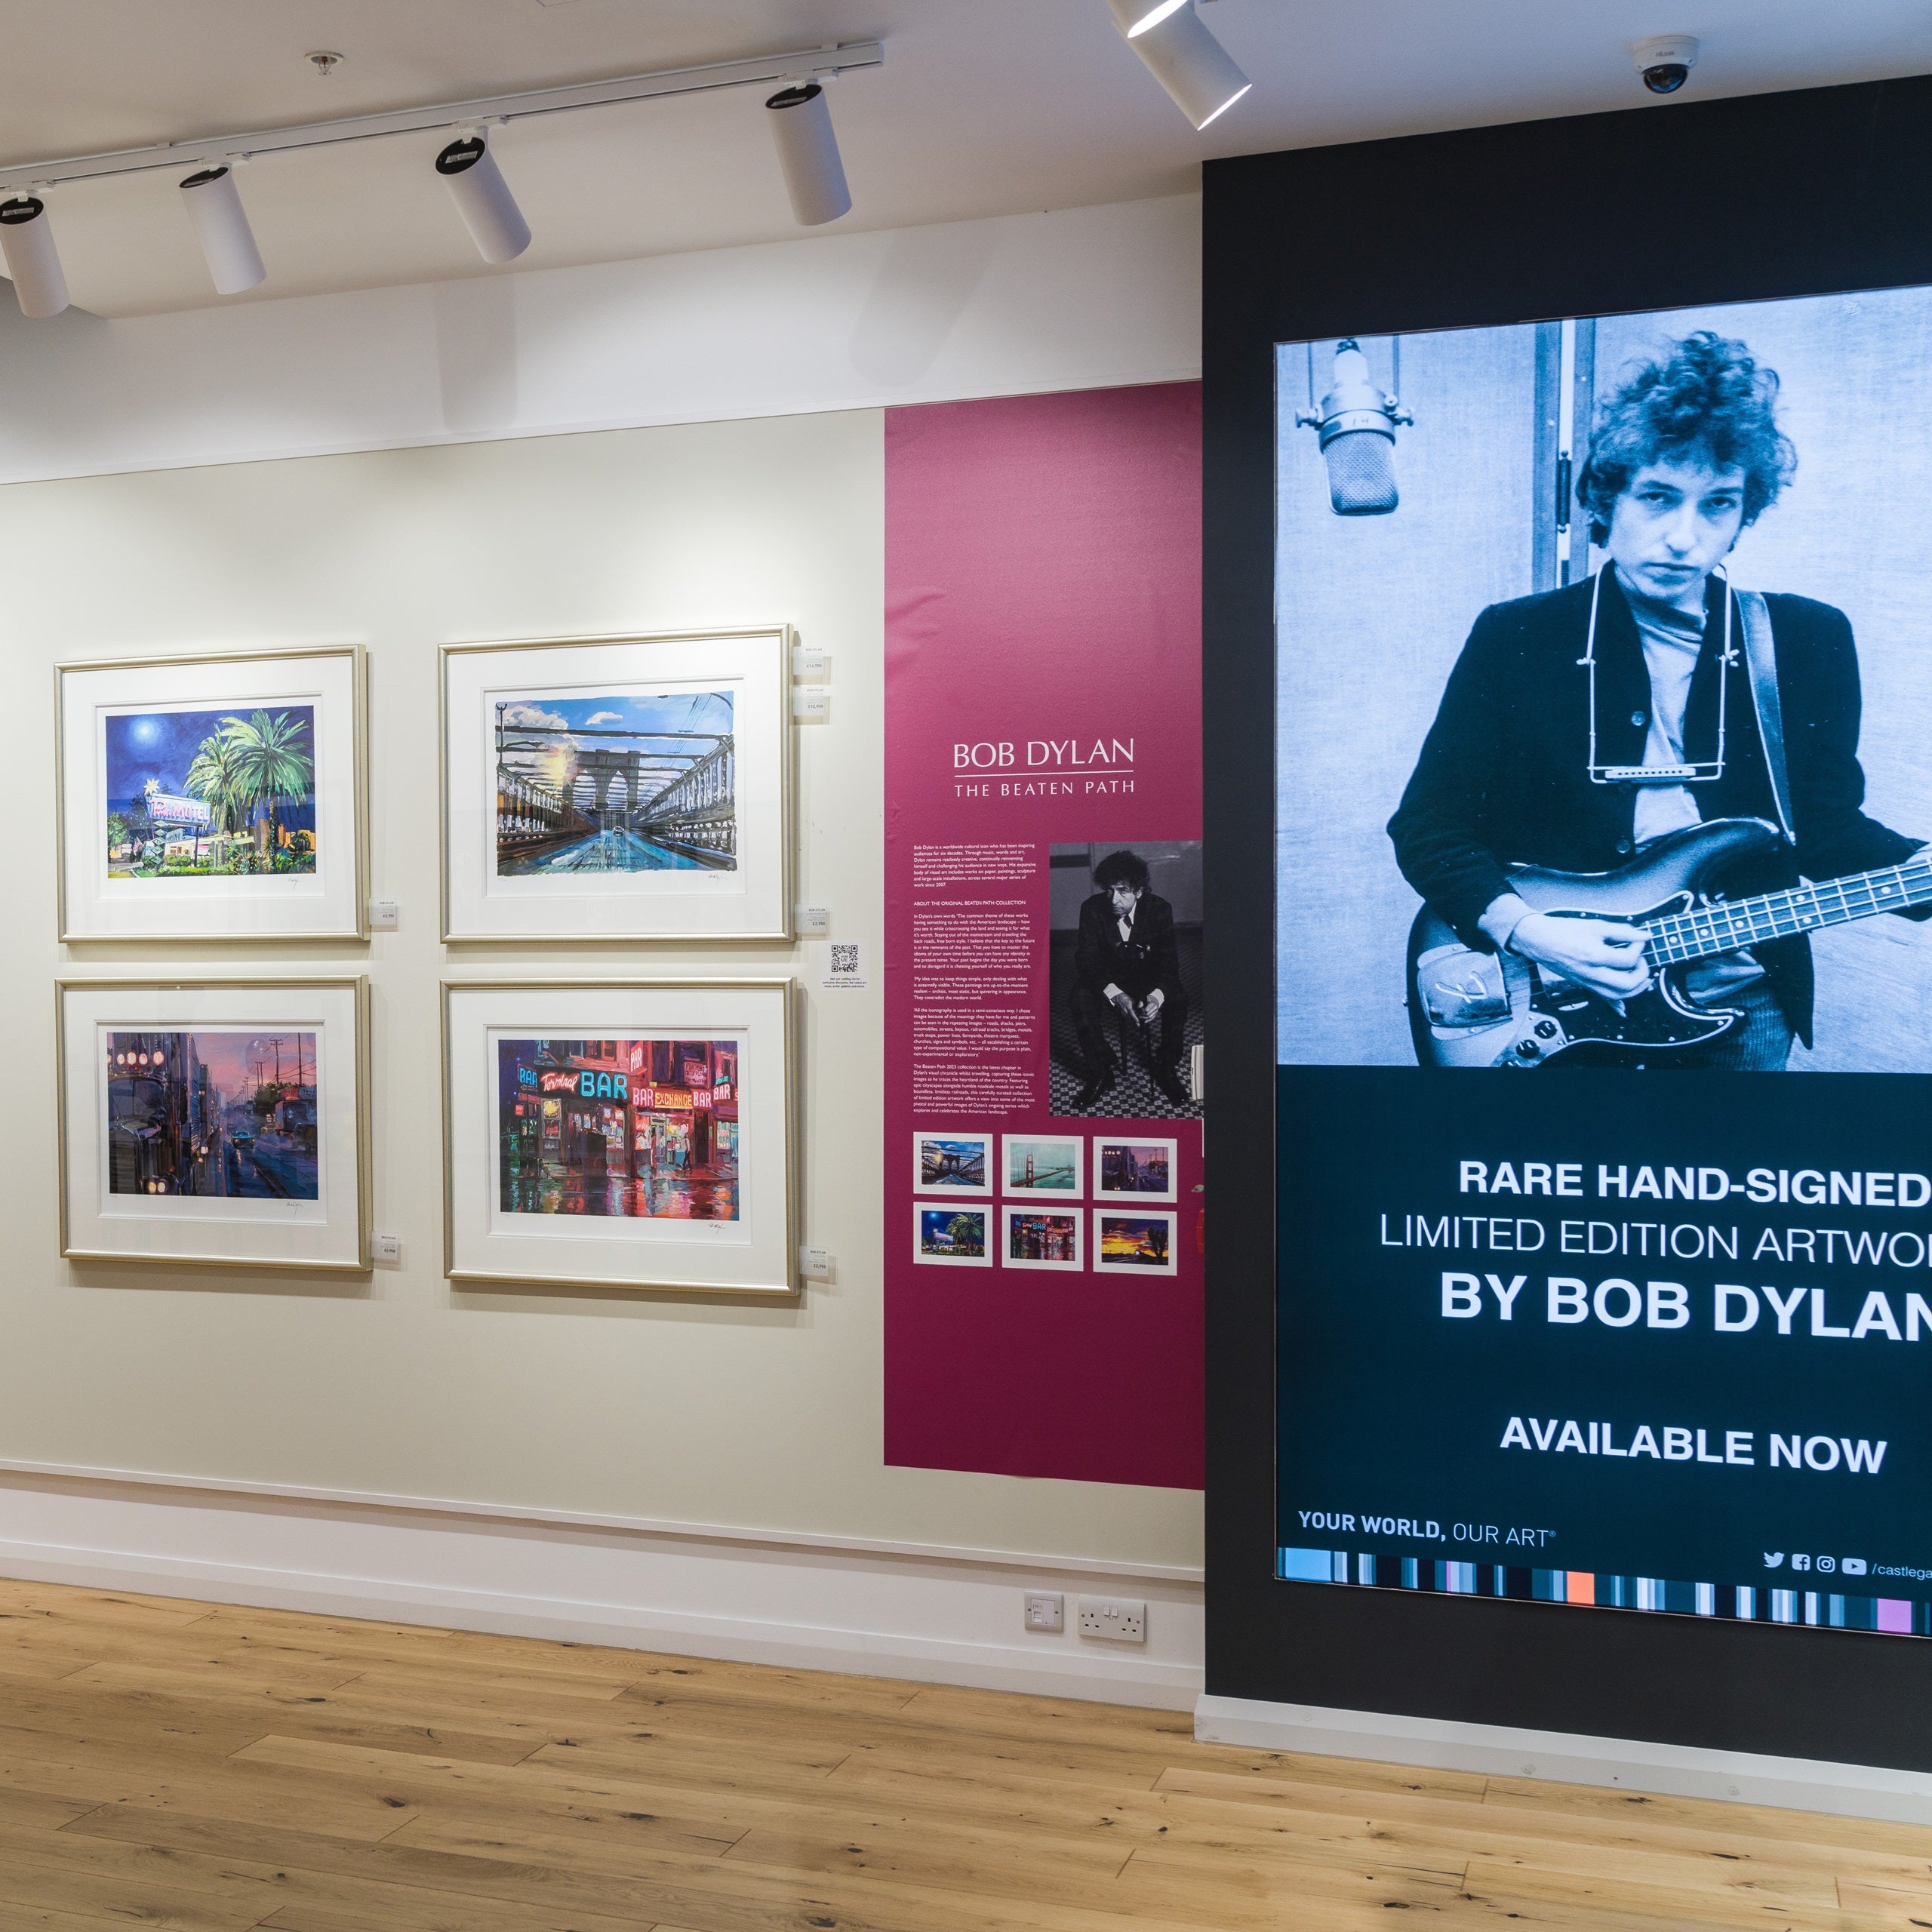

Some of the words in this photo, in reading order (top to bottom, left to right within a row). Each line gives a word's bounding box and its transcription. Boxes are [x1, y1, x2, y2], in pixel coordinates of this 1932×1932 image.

[955, 743, 1014, 768] BOB
[1028, 738, 1133, 765] DYLAN
[955, 785, 989, 797] THE
[1001, 783, 1072, 795] BEATEN
[1086, 780, 1134, 793] PATH
[580, 1070, 628, 1100] BAR
[632, 1087, 654, 1108] BAR
[693, 1091, 712, 1109] BAR
[713, 1084, 731, 1100] BAR
[1460, 1161, 1583, 1196] RARE
[1598, 1165, 1931, 1207] HAND-SIGNED
[1382, 1214, 1545, 1251] LIMITED
[1561, 1220, 1737, 1259] EDITION
[1752, 1228, 1932, 1267] ARTWO
[1442, 1272, 1527, 1320] BY
[1548, 1277, 1690, 1328] BOB
[1715, 1284, 1932, 1341] DYLAN
[1500, 1417, 1754, 1465] AVAILABLE
[1770, 1434, 1887, 1473] NOW
[1298, 1511, 1355, 1531] YOUR
[1361, 1515, 1445, 1542] WORLD,
[1454, 1524, 1498, 1543] OUR
